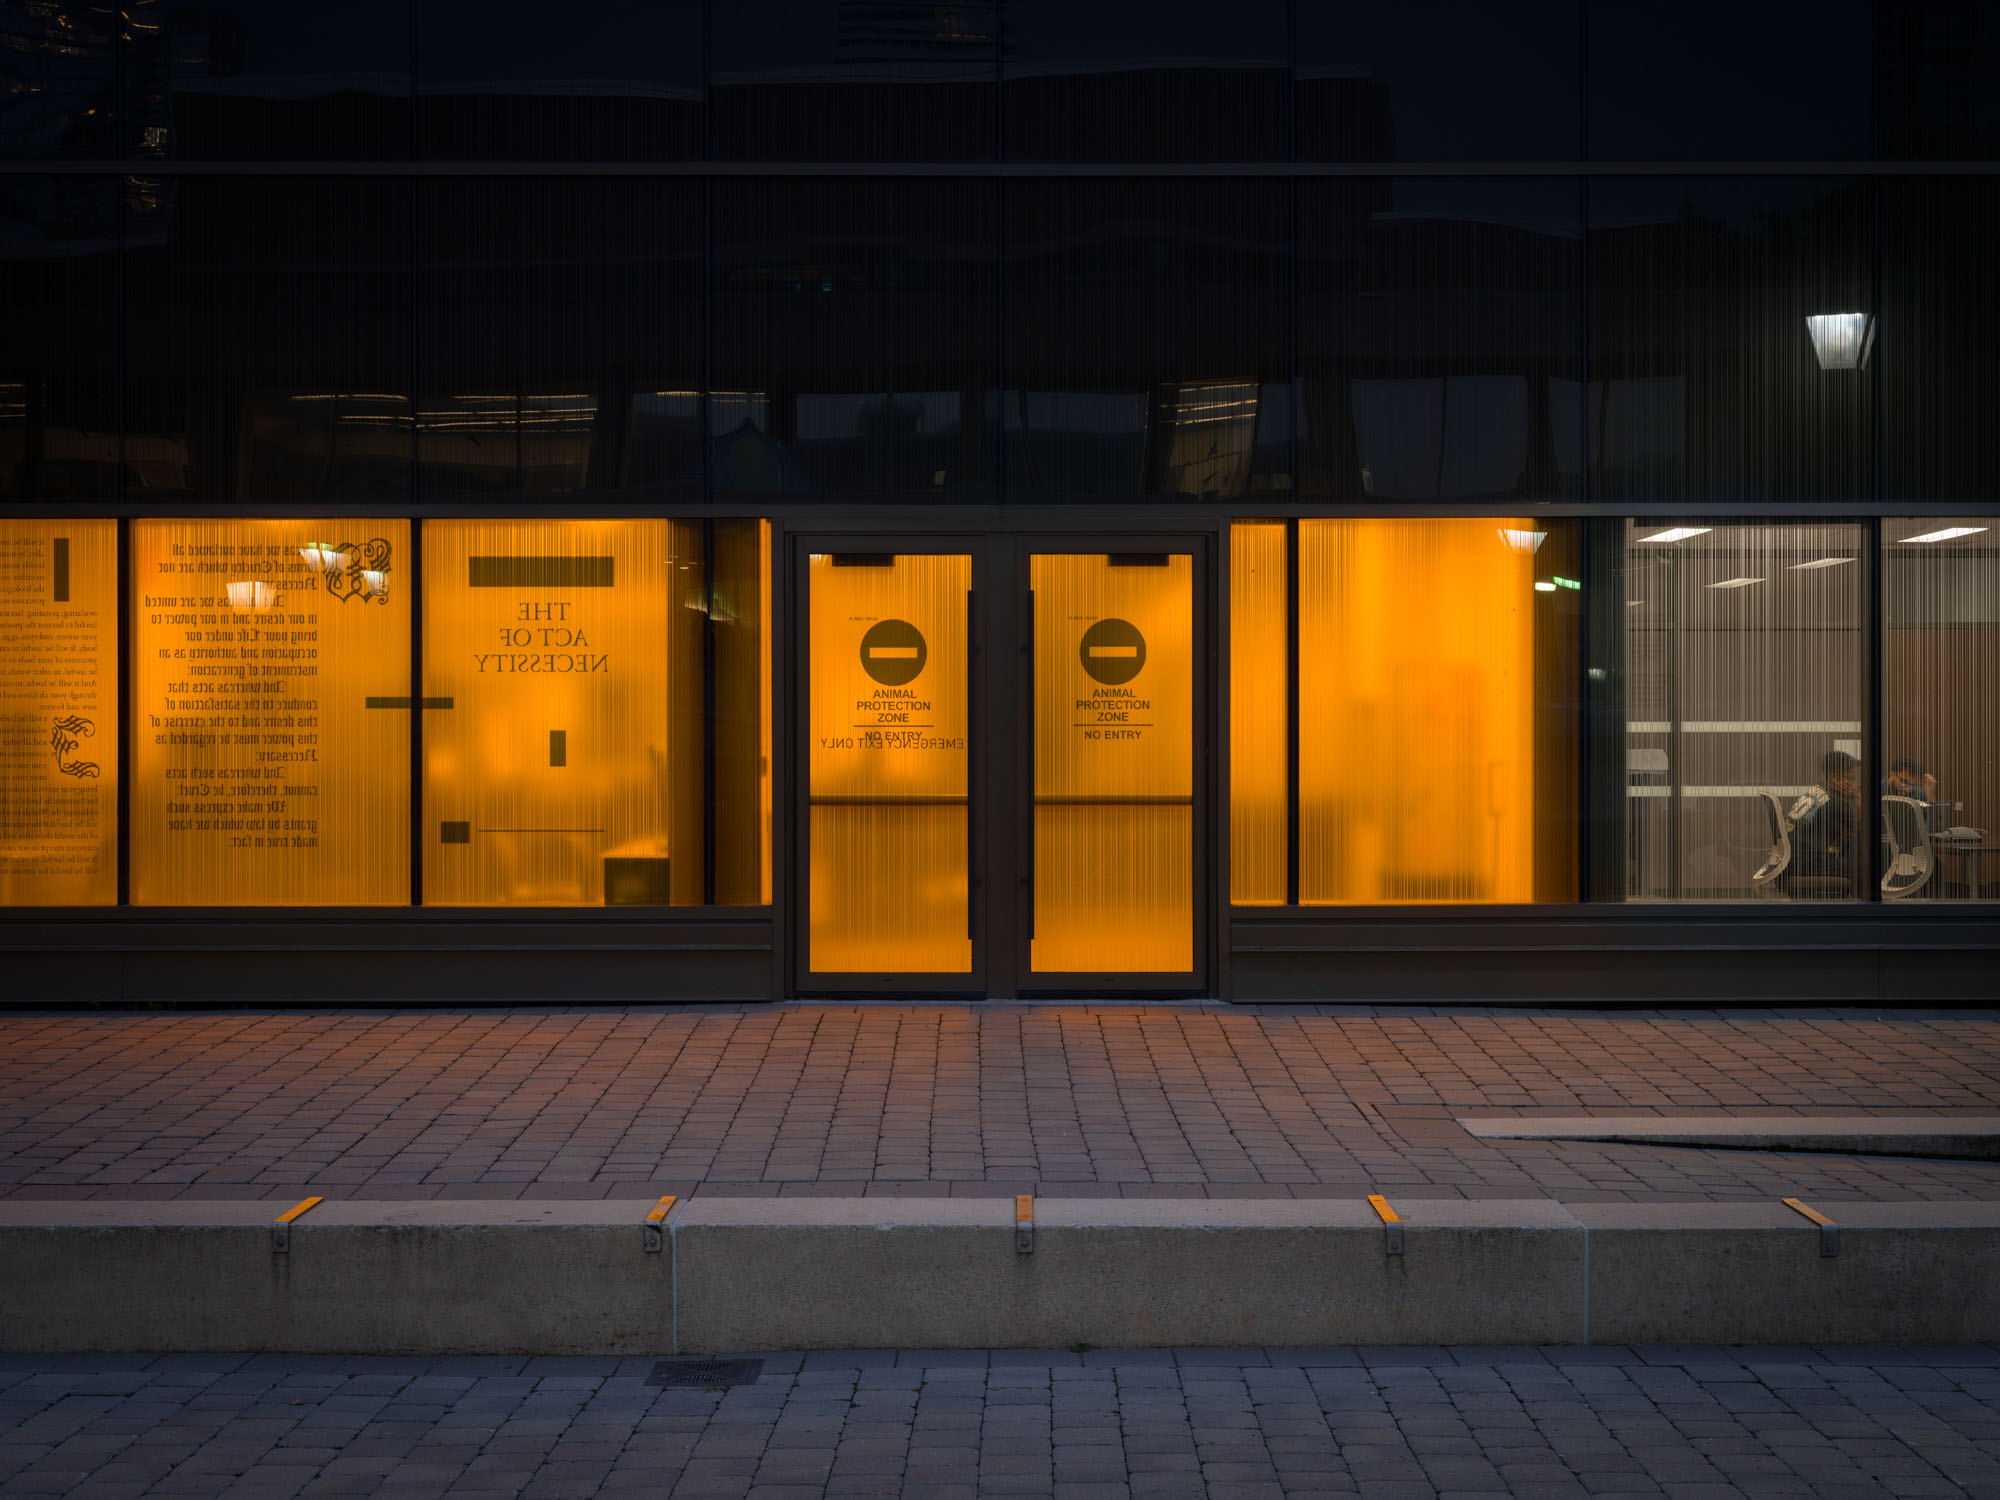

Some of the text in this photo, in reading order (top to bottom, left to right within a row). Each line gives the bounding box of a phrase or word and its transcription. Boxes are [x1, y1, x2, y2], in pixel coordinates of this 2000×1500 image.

[872, 689, 917, 699] ANIMAL
[1092, 688, 1137, 698] ANIMAL
[856, 701, 931, 711] PROTECTION
[1076, 700, 1150, 710] PROTECTION
[877, 713, 909, 723] ZONE
[1097, 712, 1129, 722] ZONE
[865, 731, 922, 741] NO ENTRY
[1084, 730, 1142, 740] NO ENTRY
